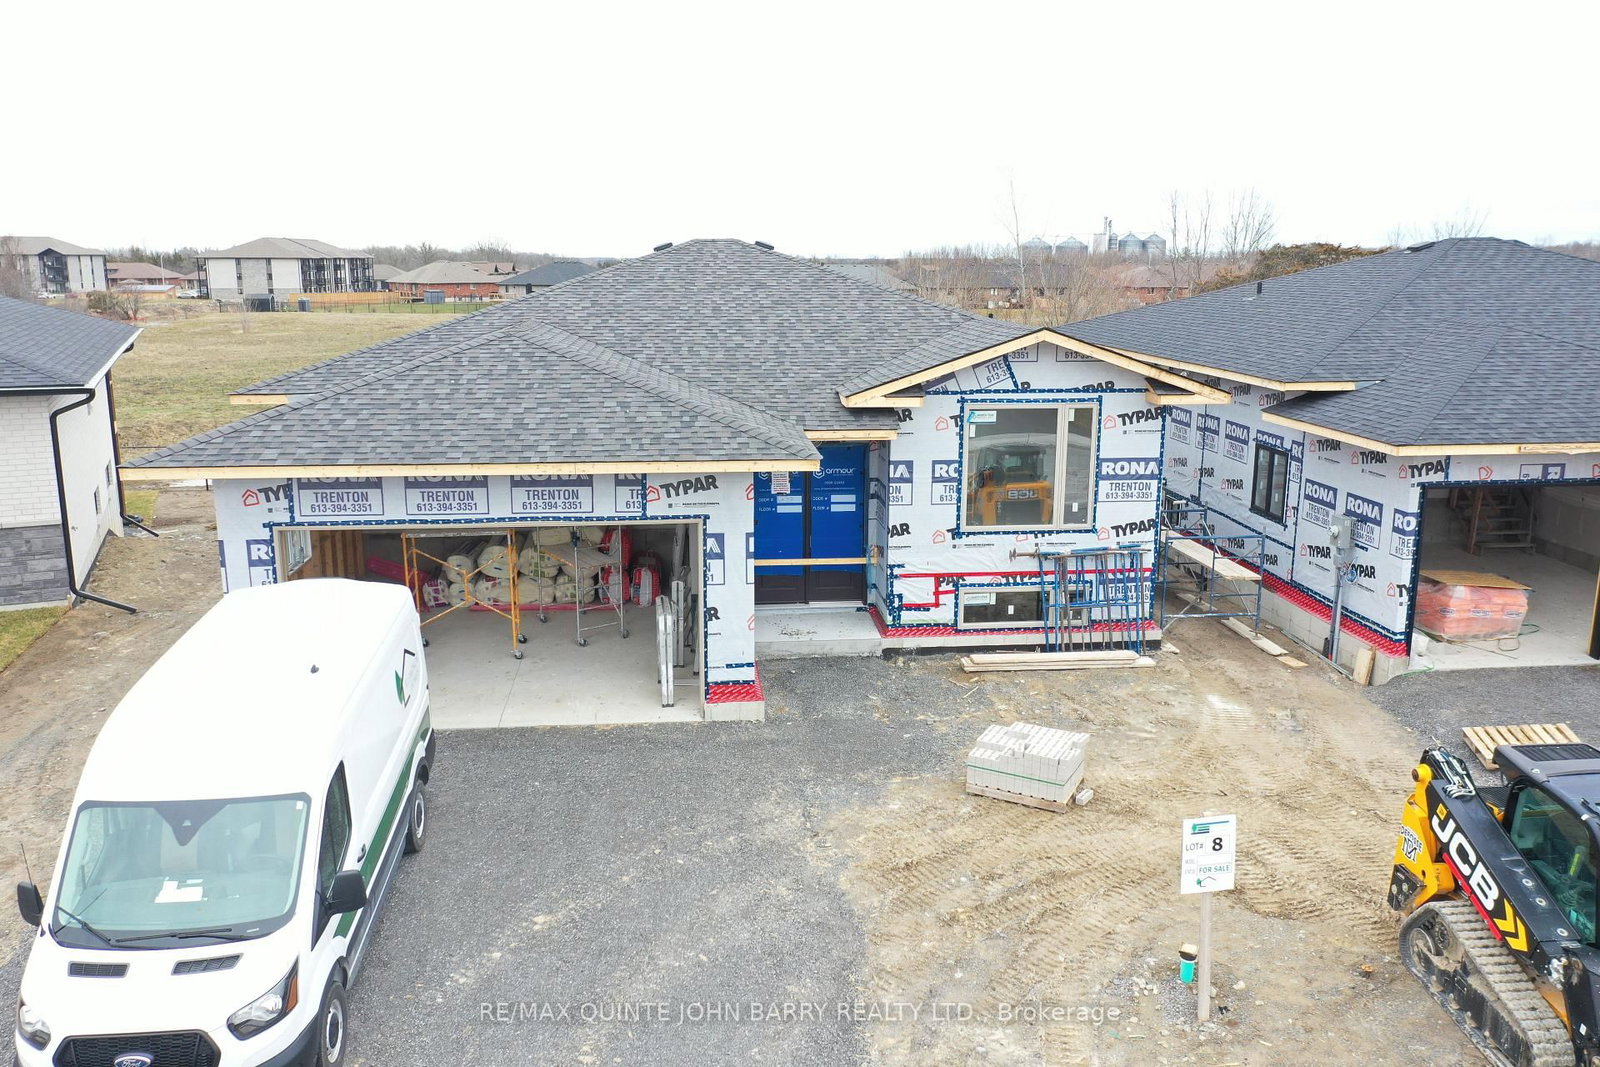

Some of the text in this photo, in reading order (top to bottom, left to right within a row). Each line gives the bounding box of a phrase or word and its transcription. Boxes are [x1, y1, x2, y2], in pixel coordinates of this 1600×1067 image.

[1233, 384, 1251, 397] TYPAR
[1172, 409, 1190, 424] RONA
[1226, 424, 1248, 440] RONA
[1317, 439, 1341, 452] TYPAR
[1173, 457, 1188, 467] TYPAR
[1360, 451, 1387, 465] TYPAR
[1101, 461, 1159, 475] RONA
[659, 474, 719, 498] TYPAR
[1109, 482, 1151, 492] TRENTON
[1226, 478, 1243, 490] TYPAR
[313, 491, 369, 503] TRENTON
[419, 490, 474, 502] TRENTON
[525, 489, 579, 500] TRENTON
[1105, 491, 1153, 500] 613-394-3351
[1305, 482, 1334, 504] RONA
[310, 503, 373, 513] 613-394-3351
[416, 502, 478, 512] 613-394-3351
[522, 501, 582, 510] 613-394-3351
[1308, 503, 1330, 518] TRENTON
[1347, 497, 1380, 520] RONA
[1307, 545, 1331, 559] TYPAR
[1212, 837, 1223, 851] 8
[1431, 814, 1500, 911] JCB
